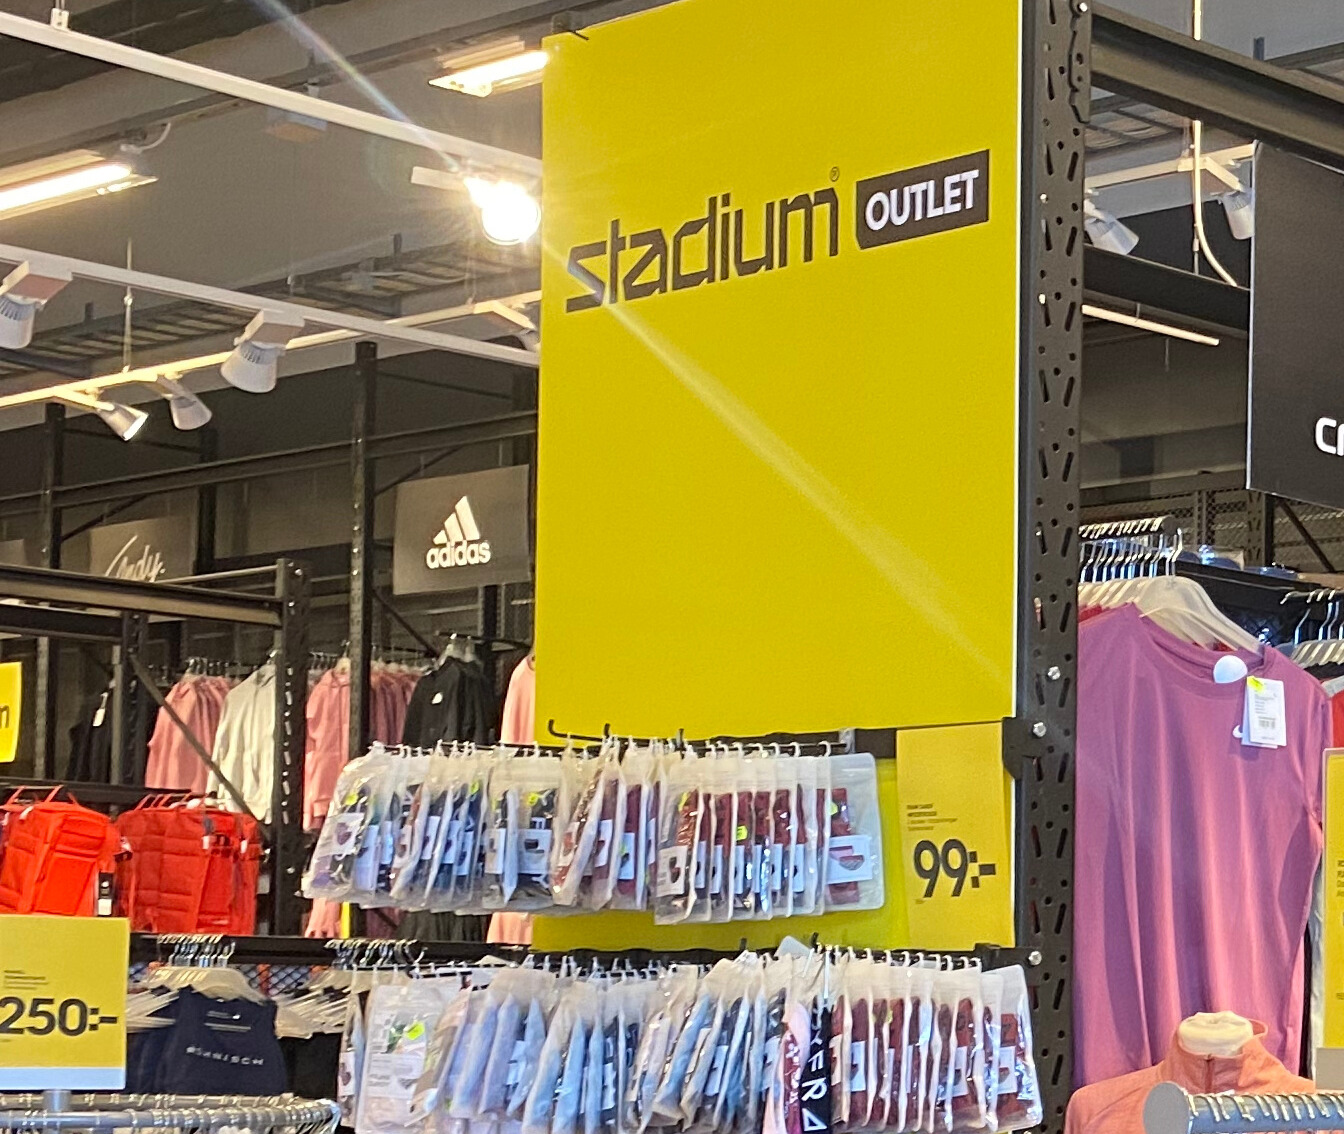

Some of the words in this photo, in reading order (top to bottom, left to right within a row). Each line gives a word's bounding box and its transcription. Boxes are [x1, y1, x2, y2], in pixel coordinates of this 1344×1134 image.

[565, 185, 839, 313] stadium
[865, 169, 980, 232] OUTLET
[426, 539, 492, 569] adidas
[913, 838, 997, 898] 99:-
[0, 995, 118, 1037] 250:-
